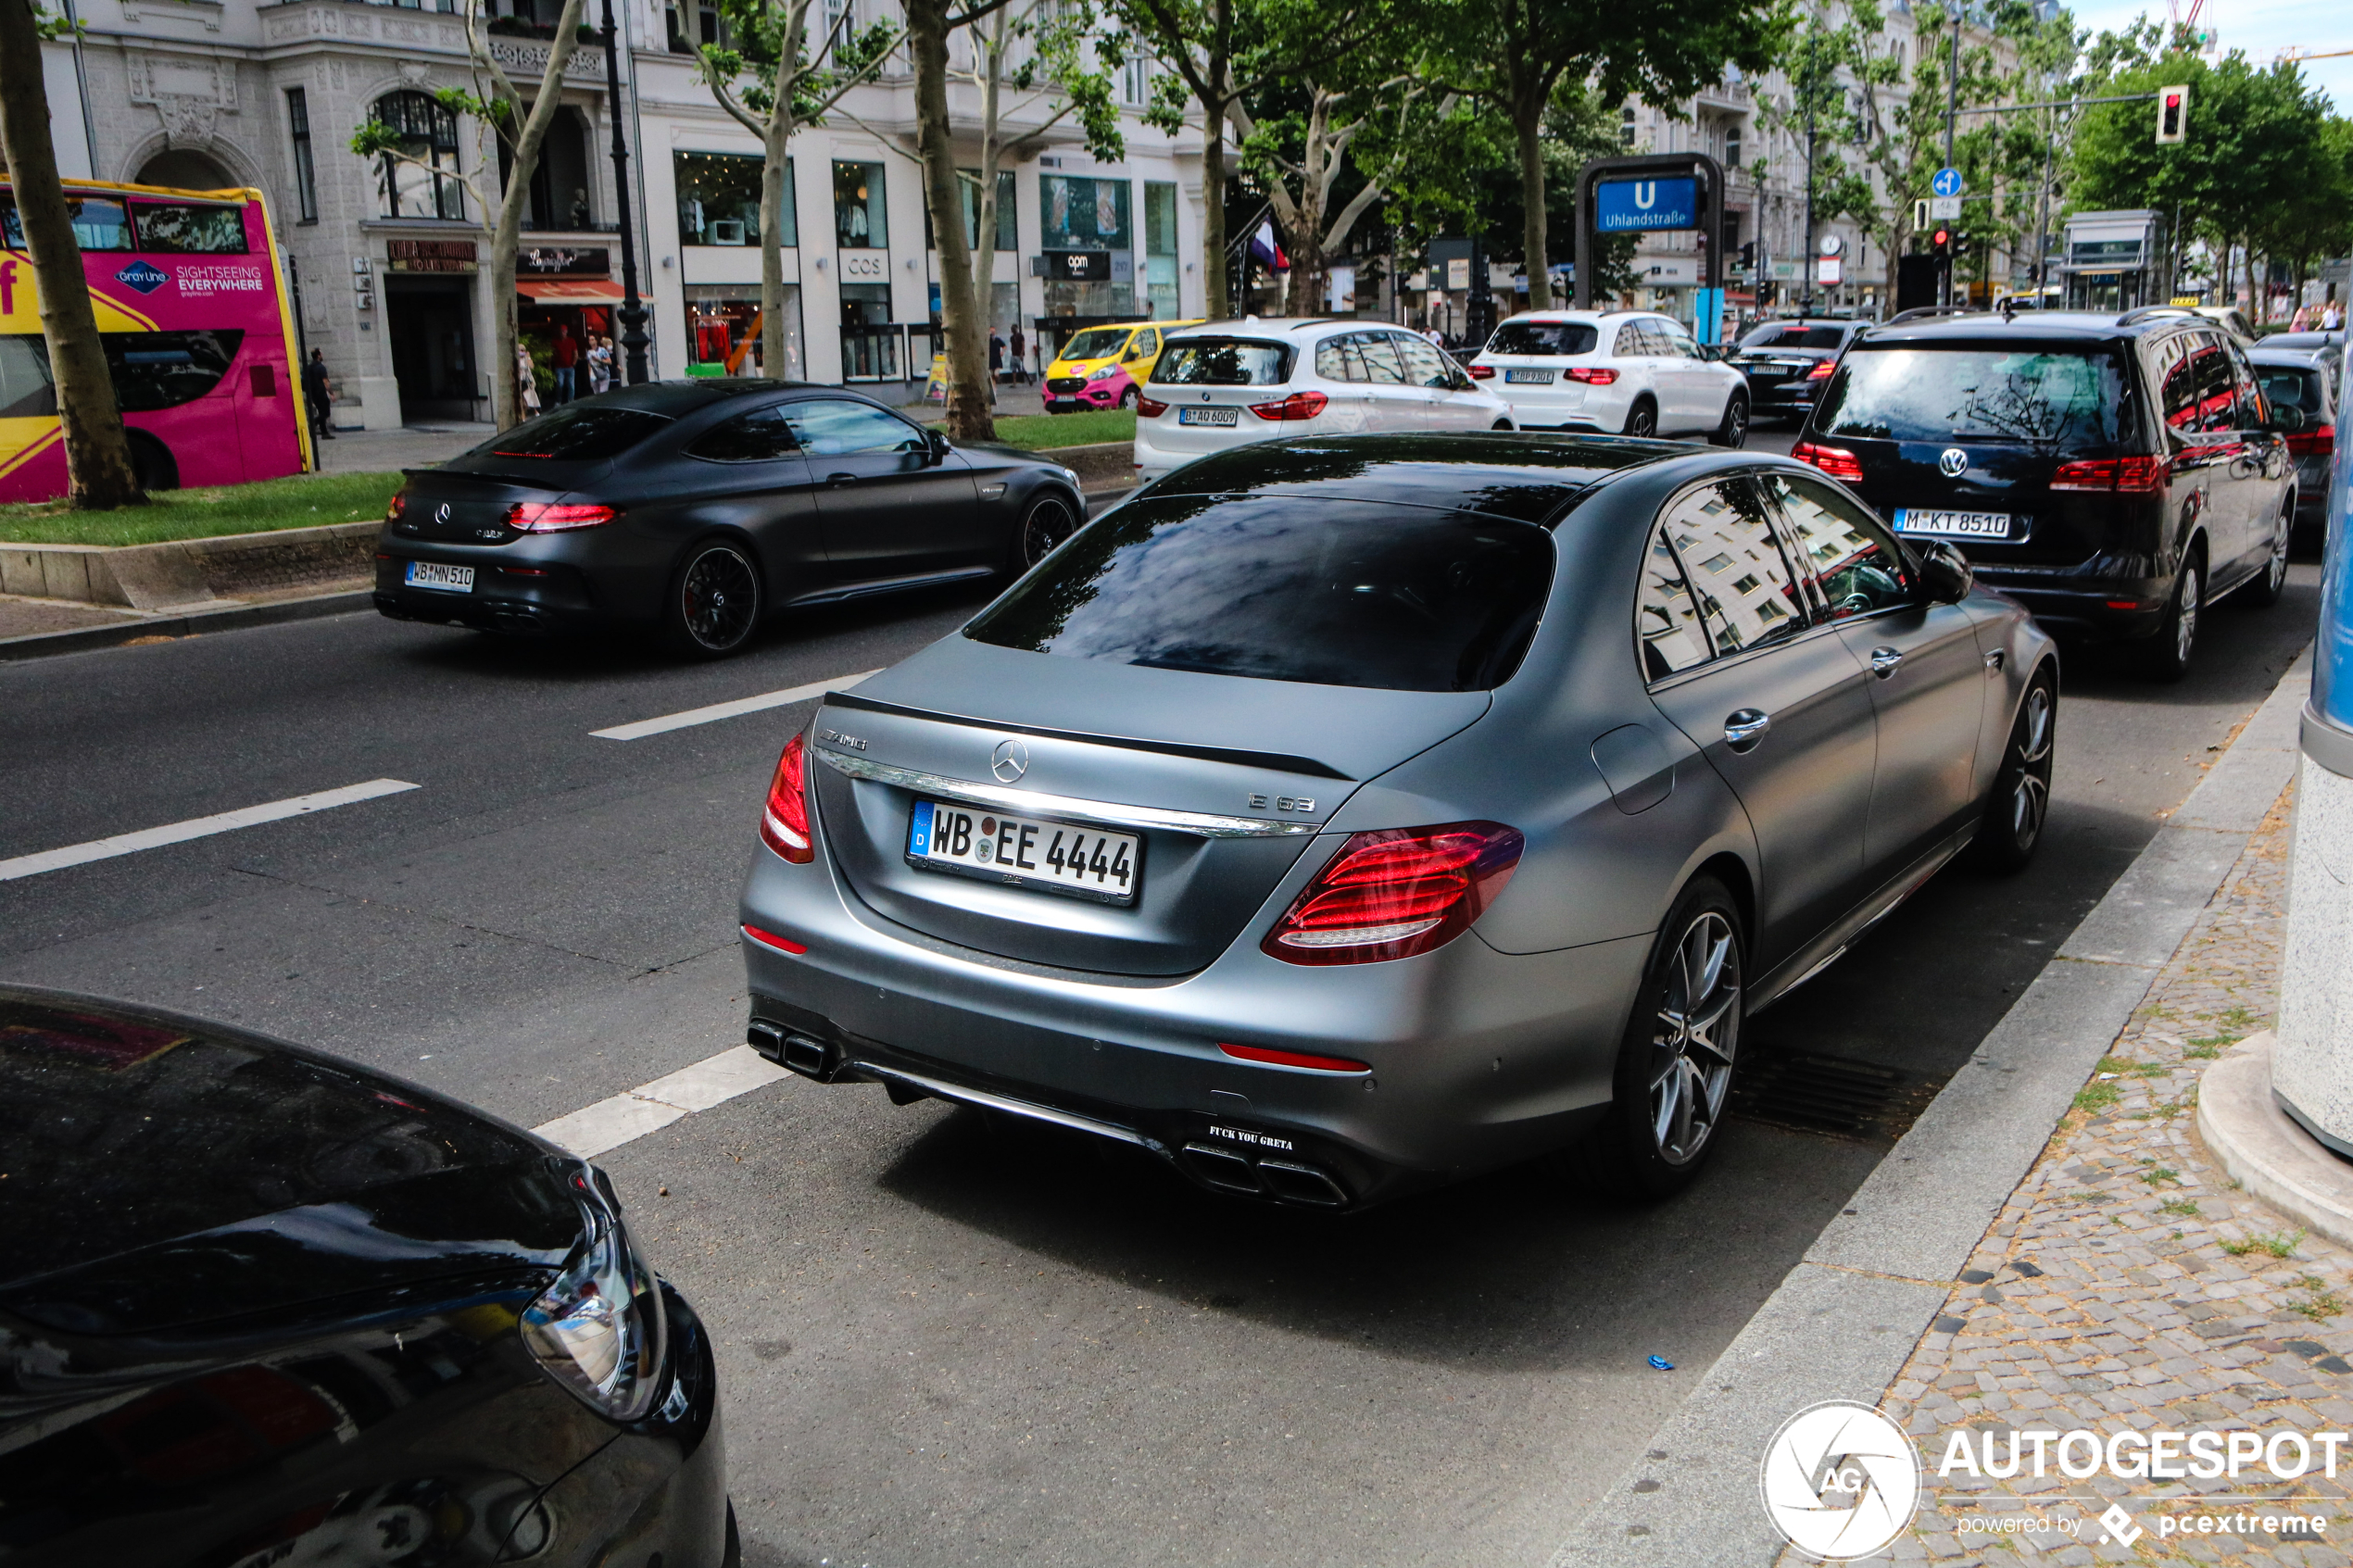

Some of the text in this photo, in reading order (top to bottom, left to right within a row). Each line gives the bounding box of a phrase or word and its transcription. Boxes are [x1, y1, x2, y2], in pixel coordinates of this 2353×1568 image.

[1635, 182, 1655, 209] U
[1605, 210, 1686, 228] Uhlandstraße
[849, 257, 881, 275] COS
[1067, 255, 1088, 271] apm
[119, 271, 166, 282] Gray Line
[176, 266, 261, 279] SIGHTSEEING
[179, 280, 263, 291] EVERYWHERE
[1186, 410, 1235, 422] B AQ 6009
[1906, 511, 1919, 529] M
[1930, 512, 1955, 531] KT
[1958, 513, 2007, 533] 8510
[413, 563, 472, 585] WB MN 510
[1249, 792, 1316, 812] E 63
[915, 809, 1130, 887] D WB EE 4444
[1210, 1126, 1293, 1151] FUCK YOU GRETA
